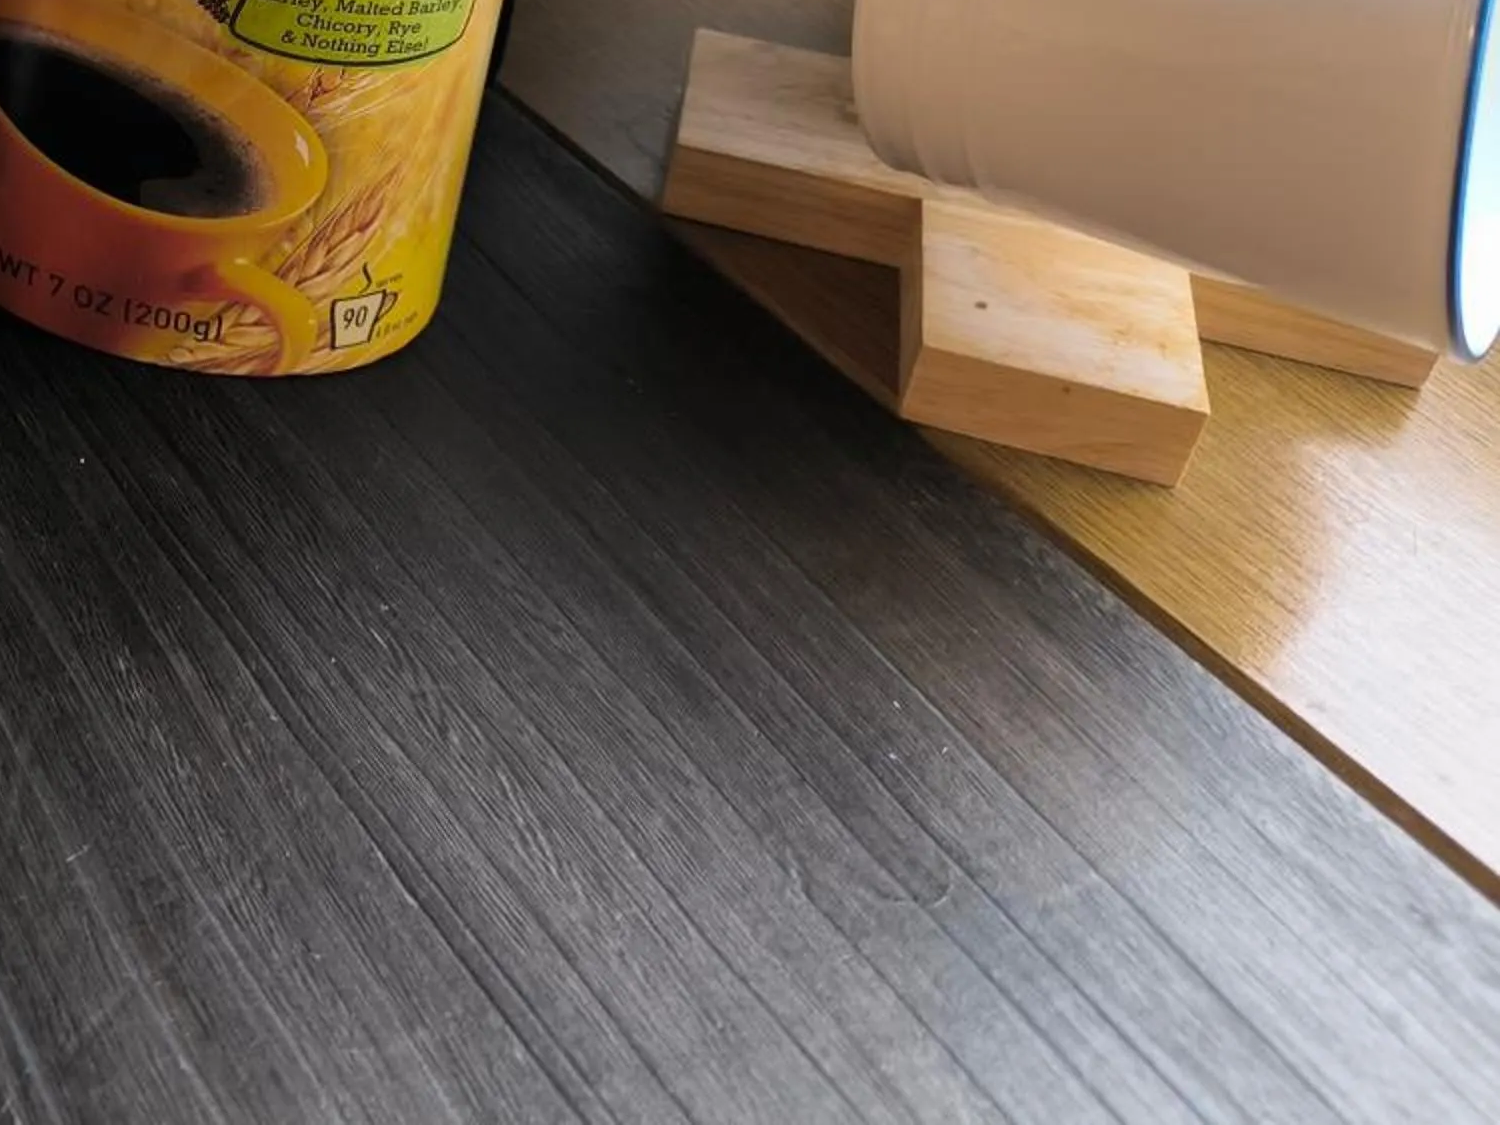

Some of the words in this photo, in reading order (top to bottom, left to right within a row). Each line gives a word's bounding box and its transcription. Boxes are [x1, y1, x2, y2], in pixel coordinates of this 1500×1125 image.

[296, 12, 381, 38] Chicory,
[388, 20, 422, 37] Rye
[280, 29, 297, 45] &
[301, 31, 380, 58] Nothing
[386, 35, 429, 54] Else!
[49, 272, 65, 298] 7
[73, 284, 115, 317] OZ
[123, 298, 224, 343] (200g)
[343, 305, 369, 331] 90
